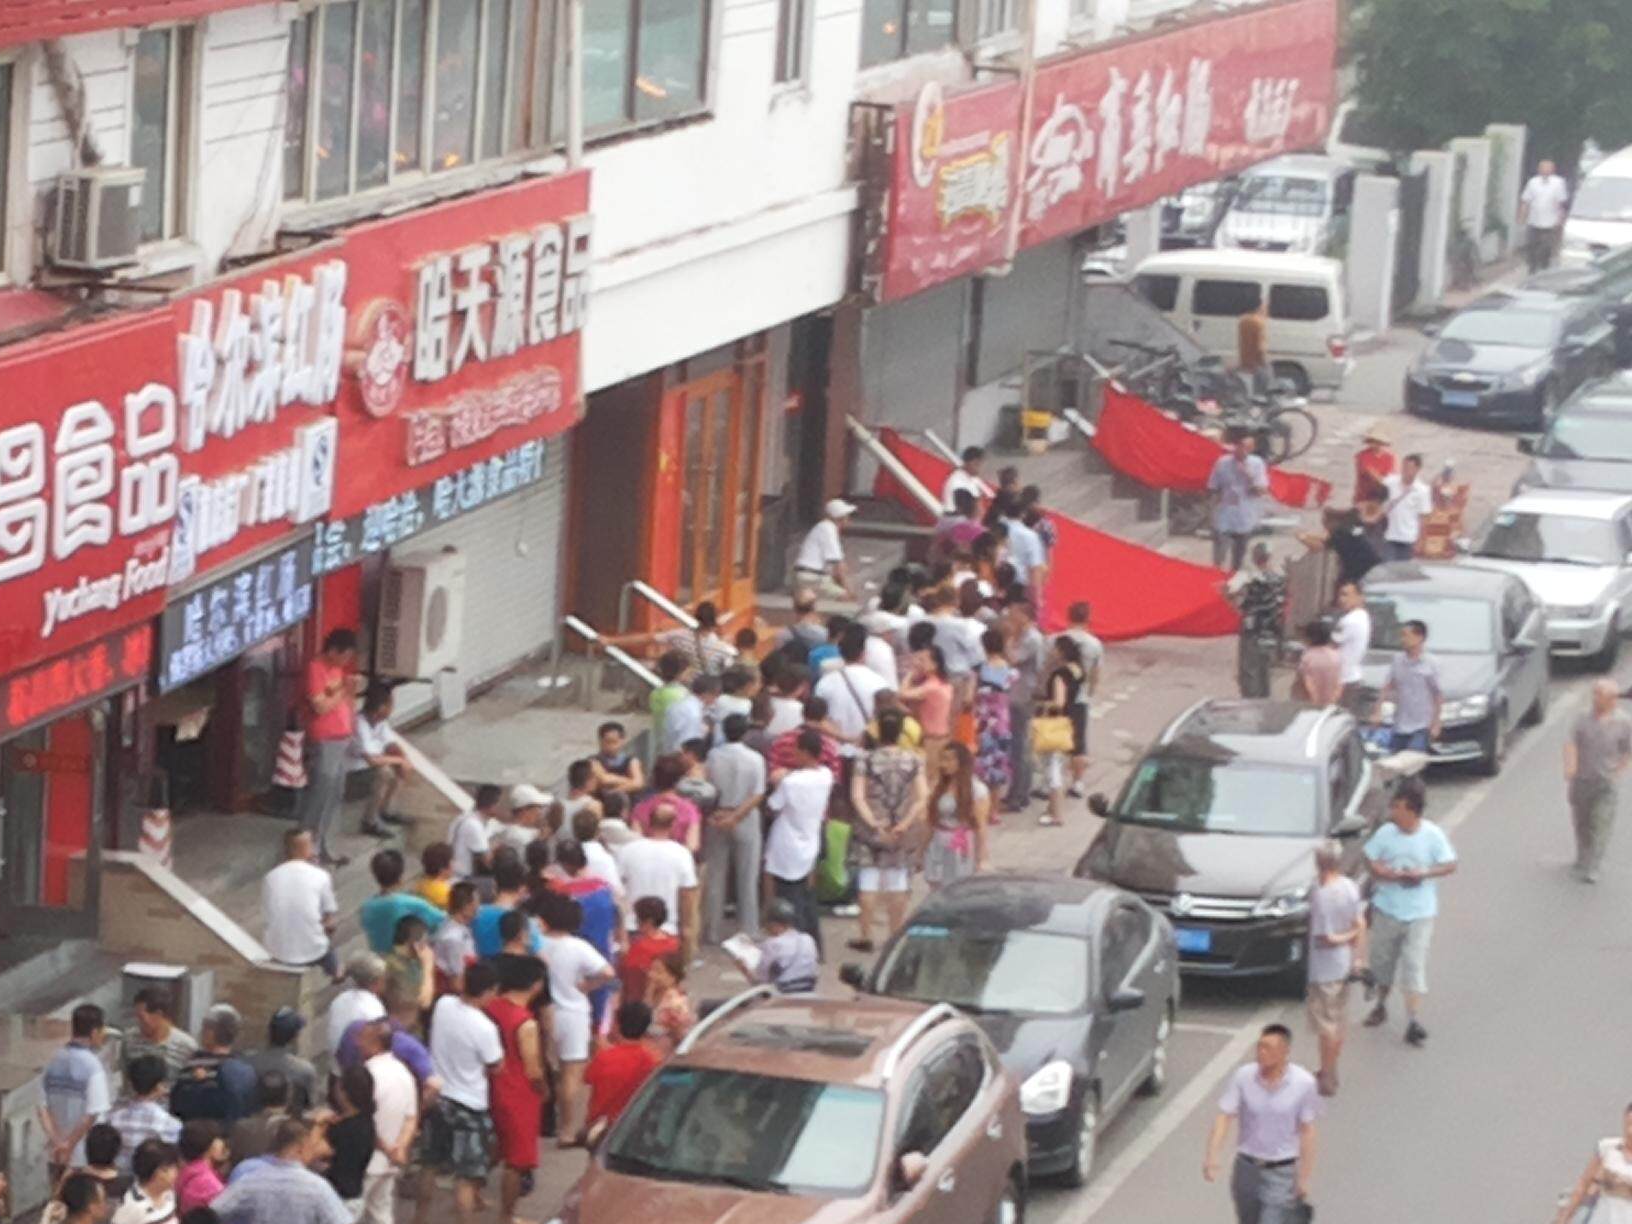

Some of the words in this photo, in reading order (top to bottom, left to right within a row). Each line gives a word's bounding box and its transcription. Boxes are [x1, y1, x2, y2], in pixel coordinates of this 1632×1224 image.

[178, 260, 346, 453] 哈尔滨红肠
[413, 214, 595, 382] 哈天源食品
[41, 571, 121, 638] Yuchang
[122, 546, 171, 602] Food
